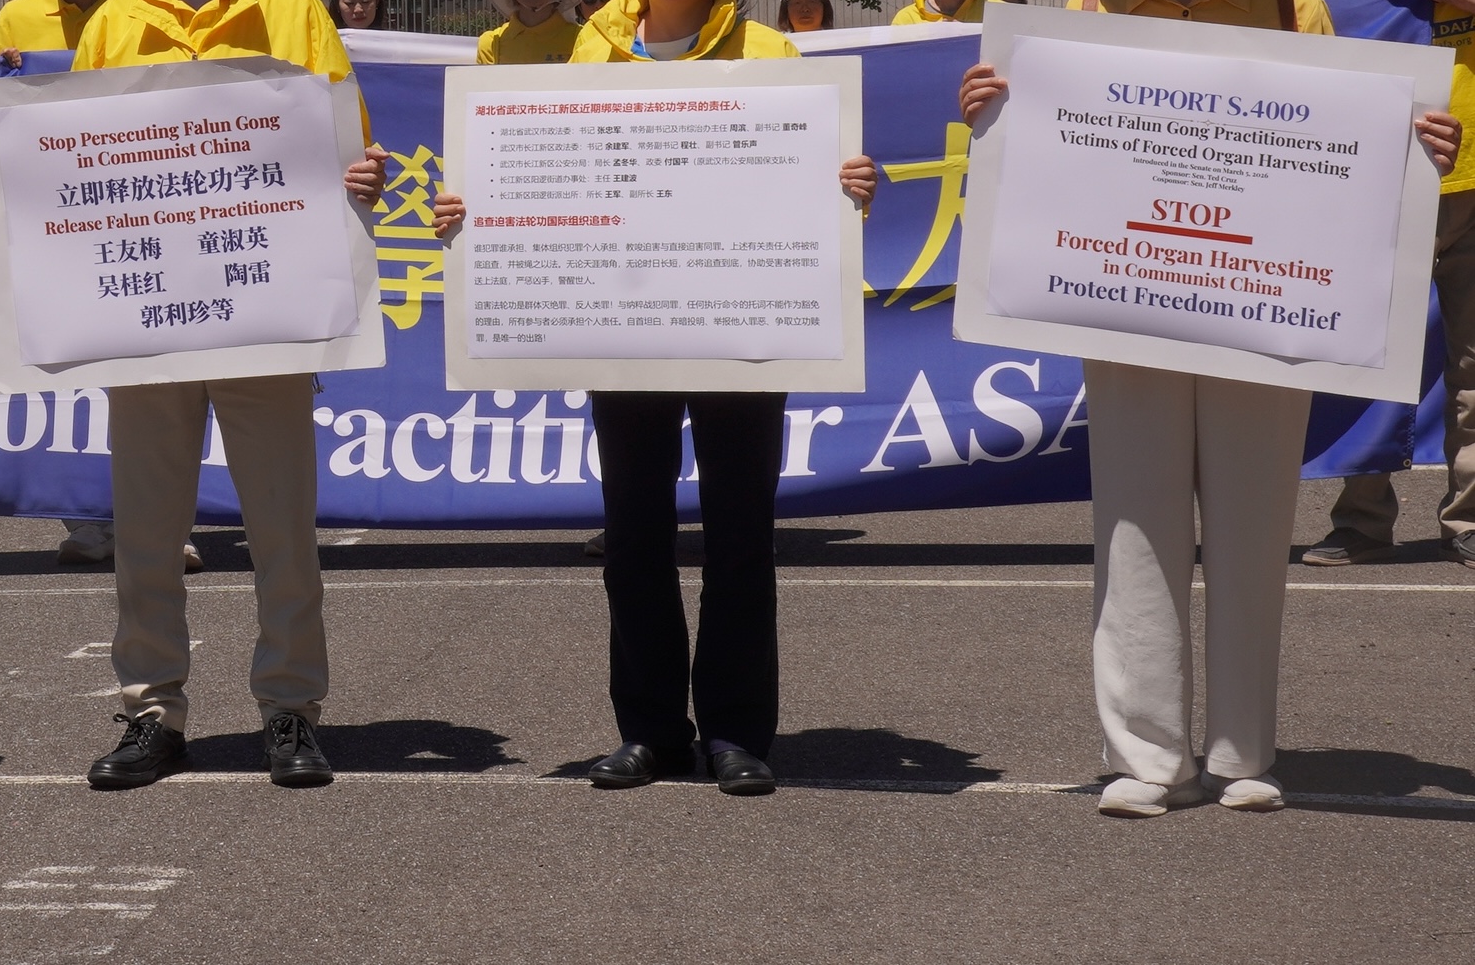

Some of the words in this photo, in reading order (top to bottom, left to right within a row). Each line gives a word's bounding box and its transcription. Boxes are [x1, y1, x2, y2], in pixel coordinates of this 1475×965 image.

[1107, 83, 1222, 113] SUPPORT
[1227, 96, 1309, 122] S.4009
[39, 137, 76, 152] Stop
[80, 124, 179, 147] Persecuting
[183, 119, 232, 136] Falun
[236, 116, 280, 131] Gong
[1057, 108, 1113, 127] Protect
[1117, 115, 1162, 132] Falun
[1167, 119, 1210, 141] Gong
[1214, 126, 1322, 151] Practitioners
[1326, 141, 1359, 155] and
[77, 153, 94, 168] in
[98, 143, 197, 166] Communist
[200, 138, 251, 155] China
[1060, 130, 1118, 149] Victims
[1123, 138, 1140, 152] of
[1143, 140, 1197, 158] Forced
[1202, 147, 1253, 166] Organ
[1259, 154, 1351, 179] Harvesting
[1133, 157, 1169, 167] Introduced
[1190, 164, 1211, 172] Senate
[56, 161, 286, 208] 立即释放法轮功学员
[1153, 176, 1189, 185] Cosponsor:
[1219, 184, 1245, 193] Merkley
[1161, 169, 1191, 178] Sponsor:
[45, 219, 102, 235] Release
[106, 213, 150, 229] Falun
[154, 210, 196, 224] Gong
[199, 200, 304, 220] Practitioners
[1152, 199, 1231, 228] STOP
[94, 237, 162, 264] 王友梅
[197, 226, 269, 255] 童淑英
[1056, 230, 1128, 256] Forced
[1135, 241, 1202, 266] Organ
[1210, 250, 1333, 286] Harvesting
[98, 271, 167, 299] 吴桂红
[225, 260, 270, 287] 陶雷
[1103, 259, 1119, 275] in
[1125, 263, 1225, 289] Communist
[1230, 277, 1282, 296] China
[141, 298, 234, 328] 郭利珍等
[1048, 275, 1128, 302] Protect
[1134, 287, 1234, 317] Freedom
[1241, 302, 1267, 321] of
[1270, 305, 1341, 331] Belief
